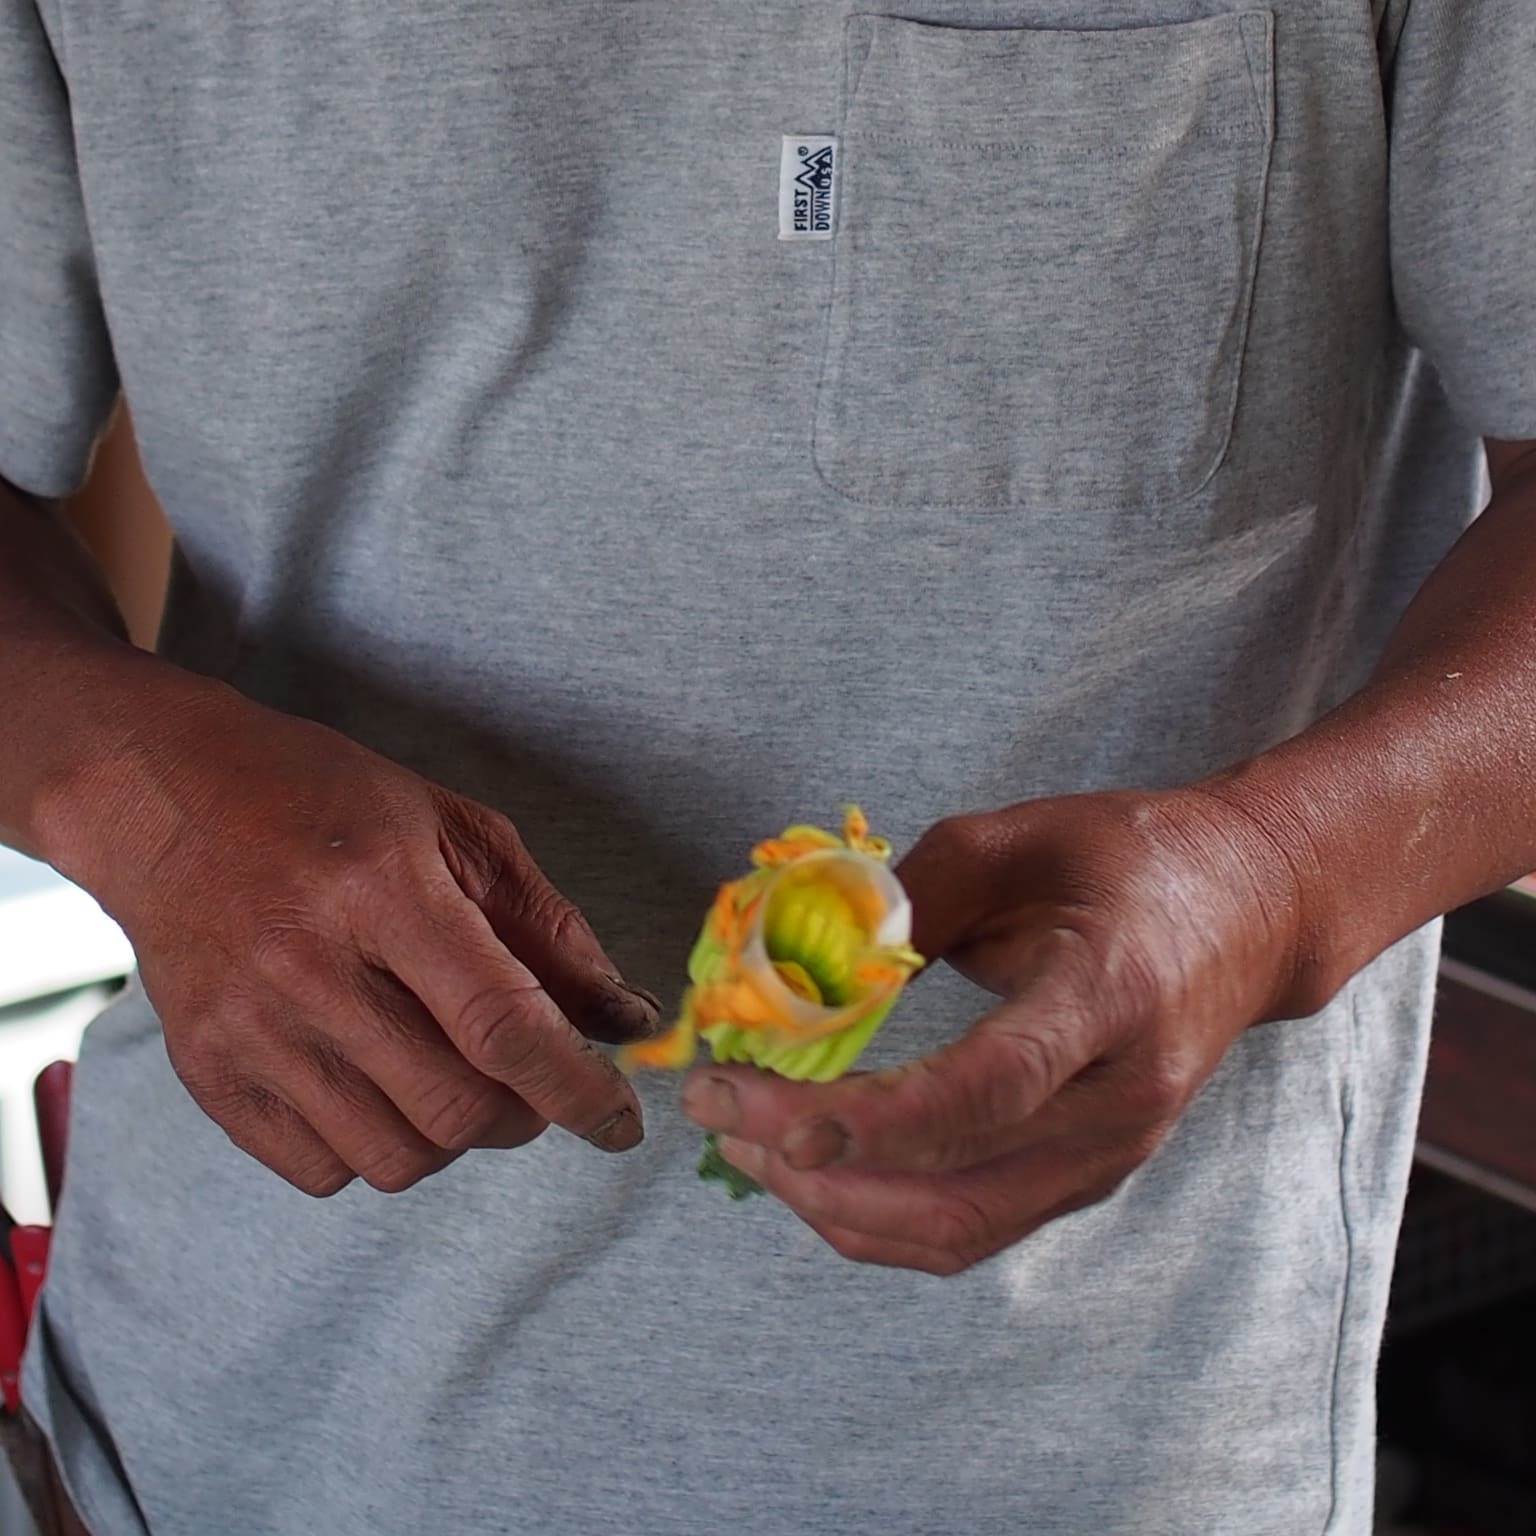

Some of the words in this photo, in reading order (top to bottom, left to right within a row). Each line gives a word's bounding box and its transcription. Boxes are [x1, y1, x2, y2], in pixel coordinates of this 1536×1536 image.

[820, 154, 833, 187] USA
[794, 188, 809, 232] FIRST
[814, 190, 831, 232] DOWN
